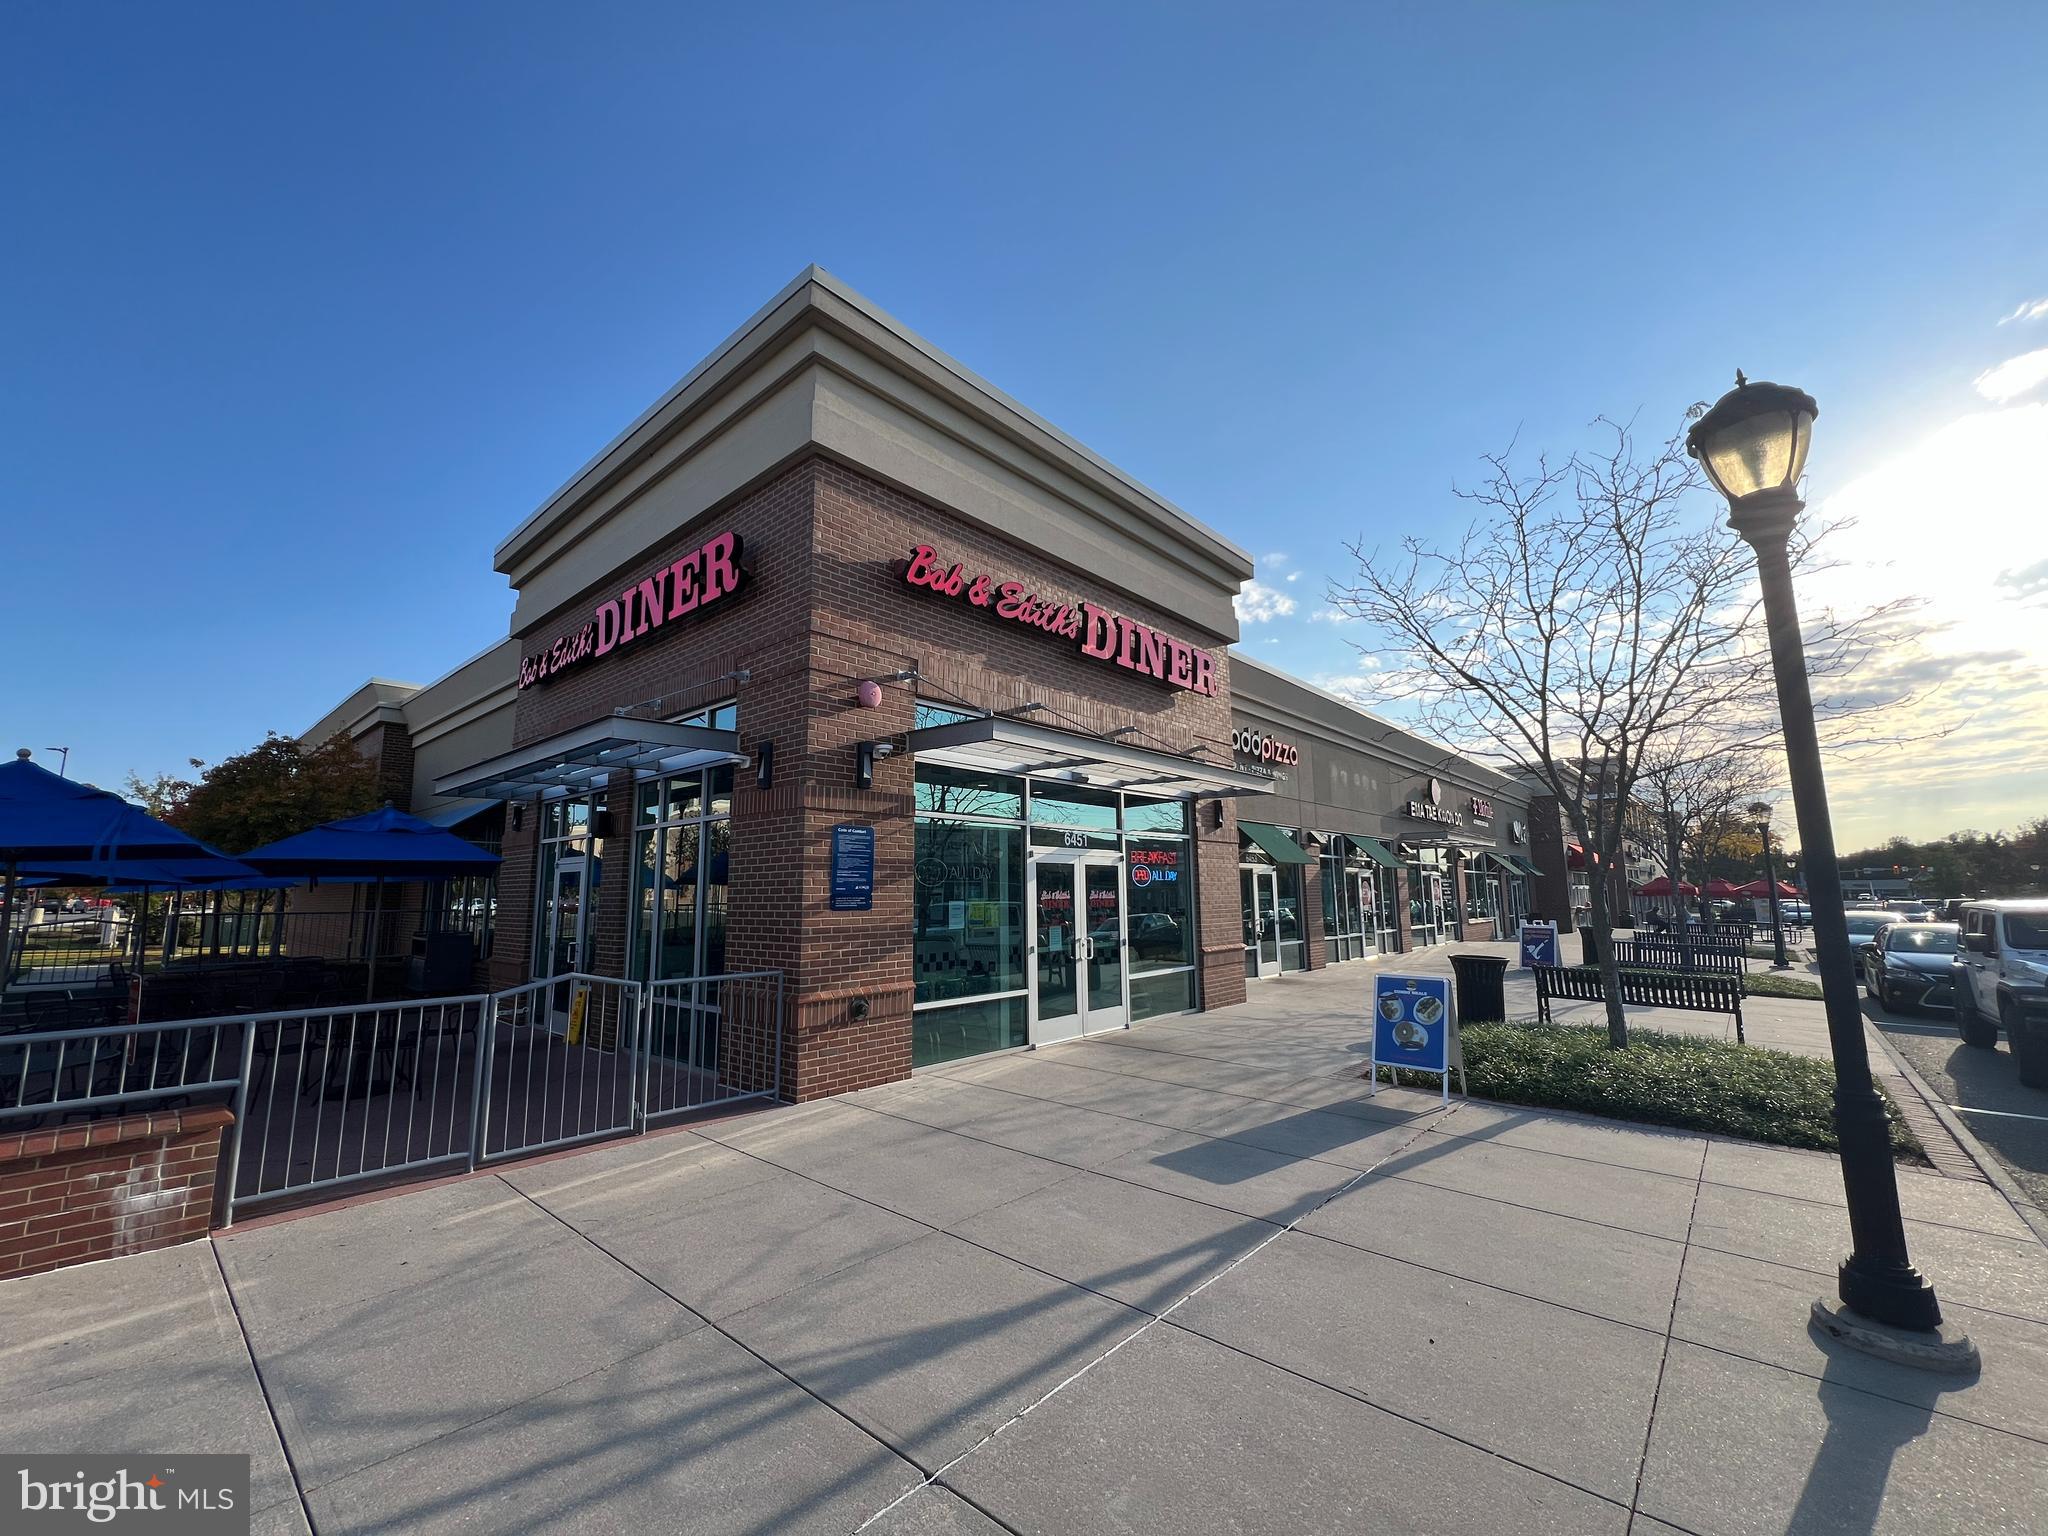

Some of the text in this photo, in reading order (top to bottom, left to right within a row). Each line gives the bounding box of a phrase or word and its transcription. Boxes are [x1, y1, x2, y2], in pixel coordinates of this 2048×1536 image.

[518, 531, 739, 690] Bob & Edith's DINER
[906, 545, 1219, 699] Bob & Edith's DINER
[1064, 832, 1088, 847] 6451
[1130, 850, 1177, 864] BREAKFAST
[1152, 870, 1164, 881] ALL
